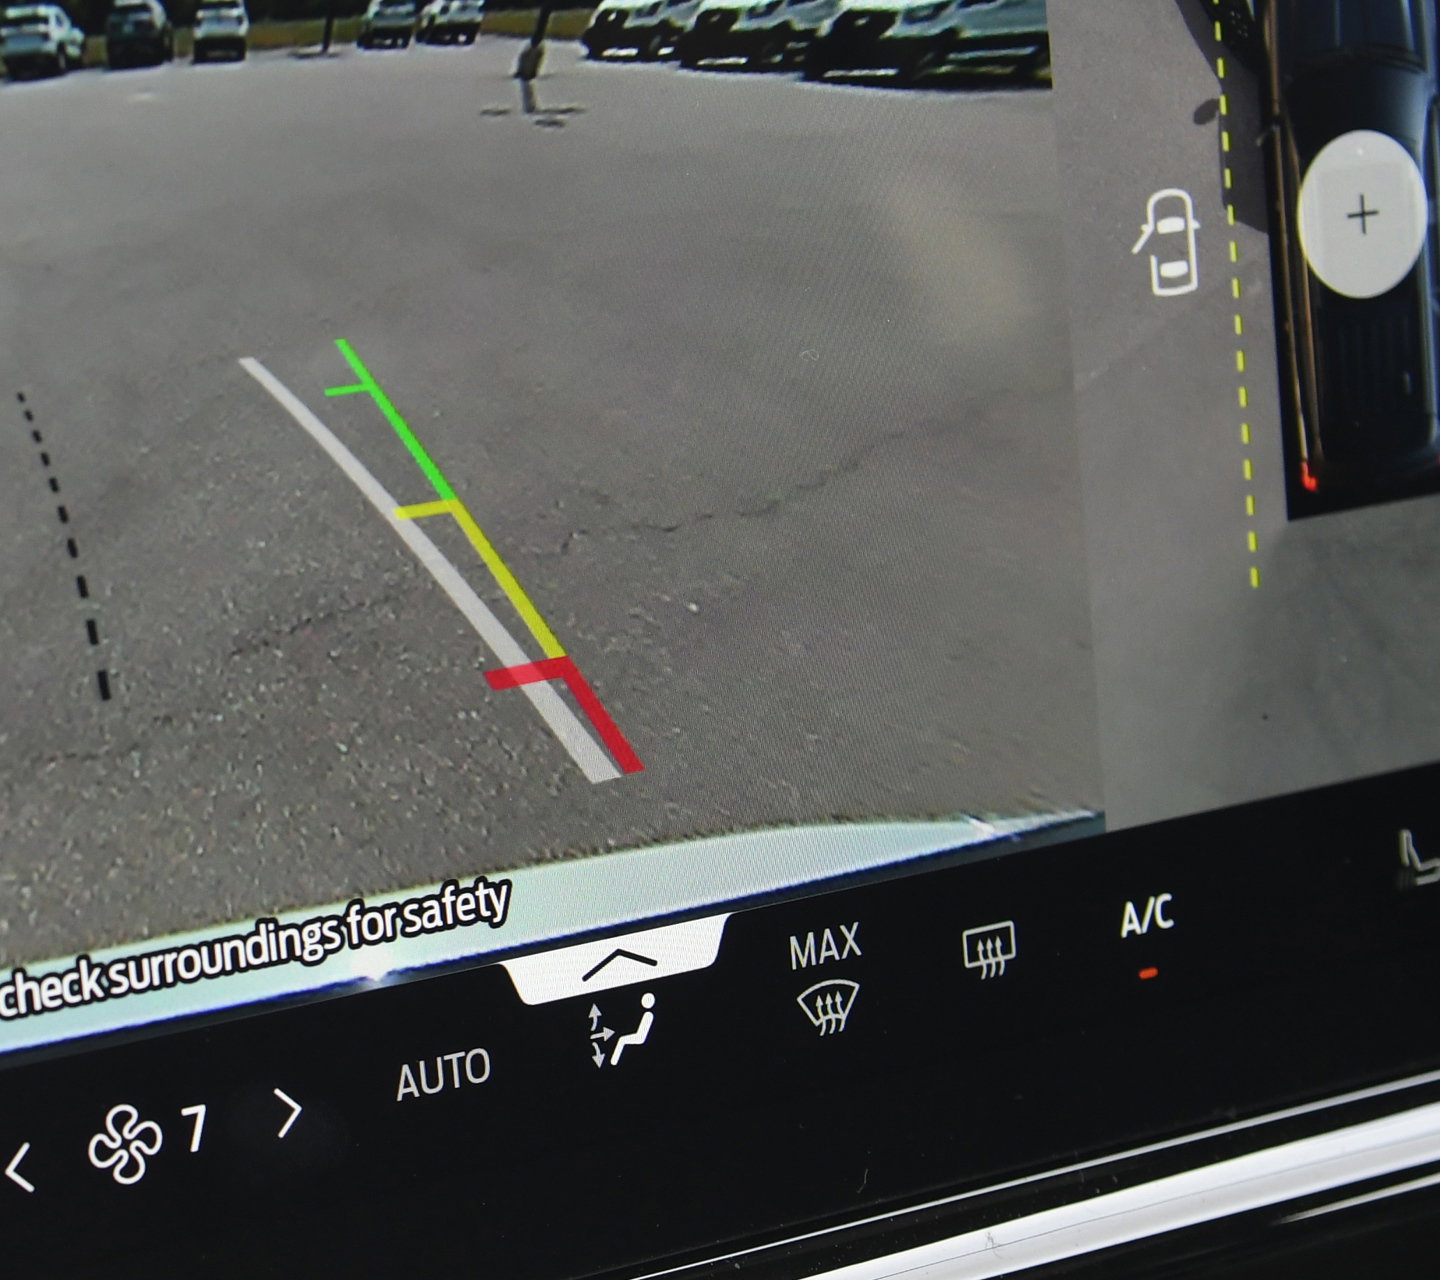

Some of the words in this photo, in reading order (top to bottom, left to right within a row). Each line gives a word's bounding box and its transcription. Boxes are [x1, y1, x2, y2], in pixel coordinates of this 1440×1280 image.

[108, 922, 342, 997] surroundings
[345, 900, 402, 949] for
[403, 879, 512, 931] safety
[1121, 894, 1174, 938] A/C
[790, 922, 861, 970] MAX
[396, 1048, 491, 1101] AUTO
[182, 1103, 206, 1152] 7
